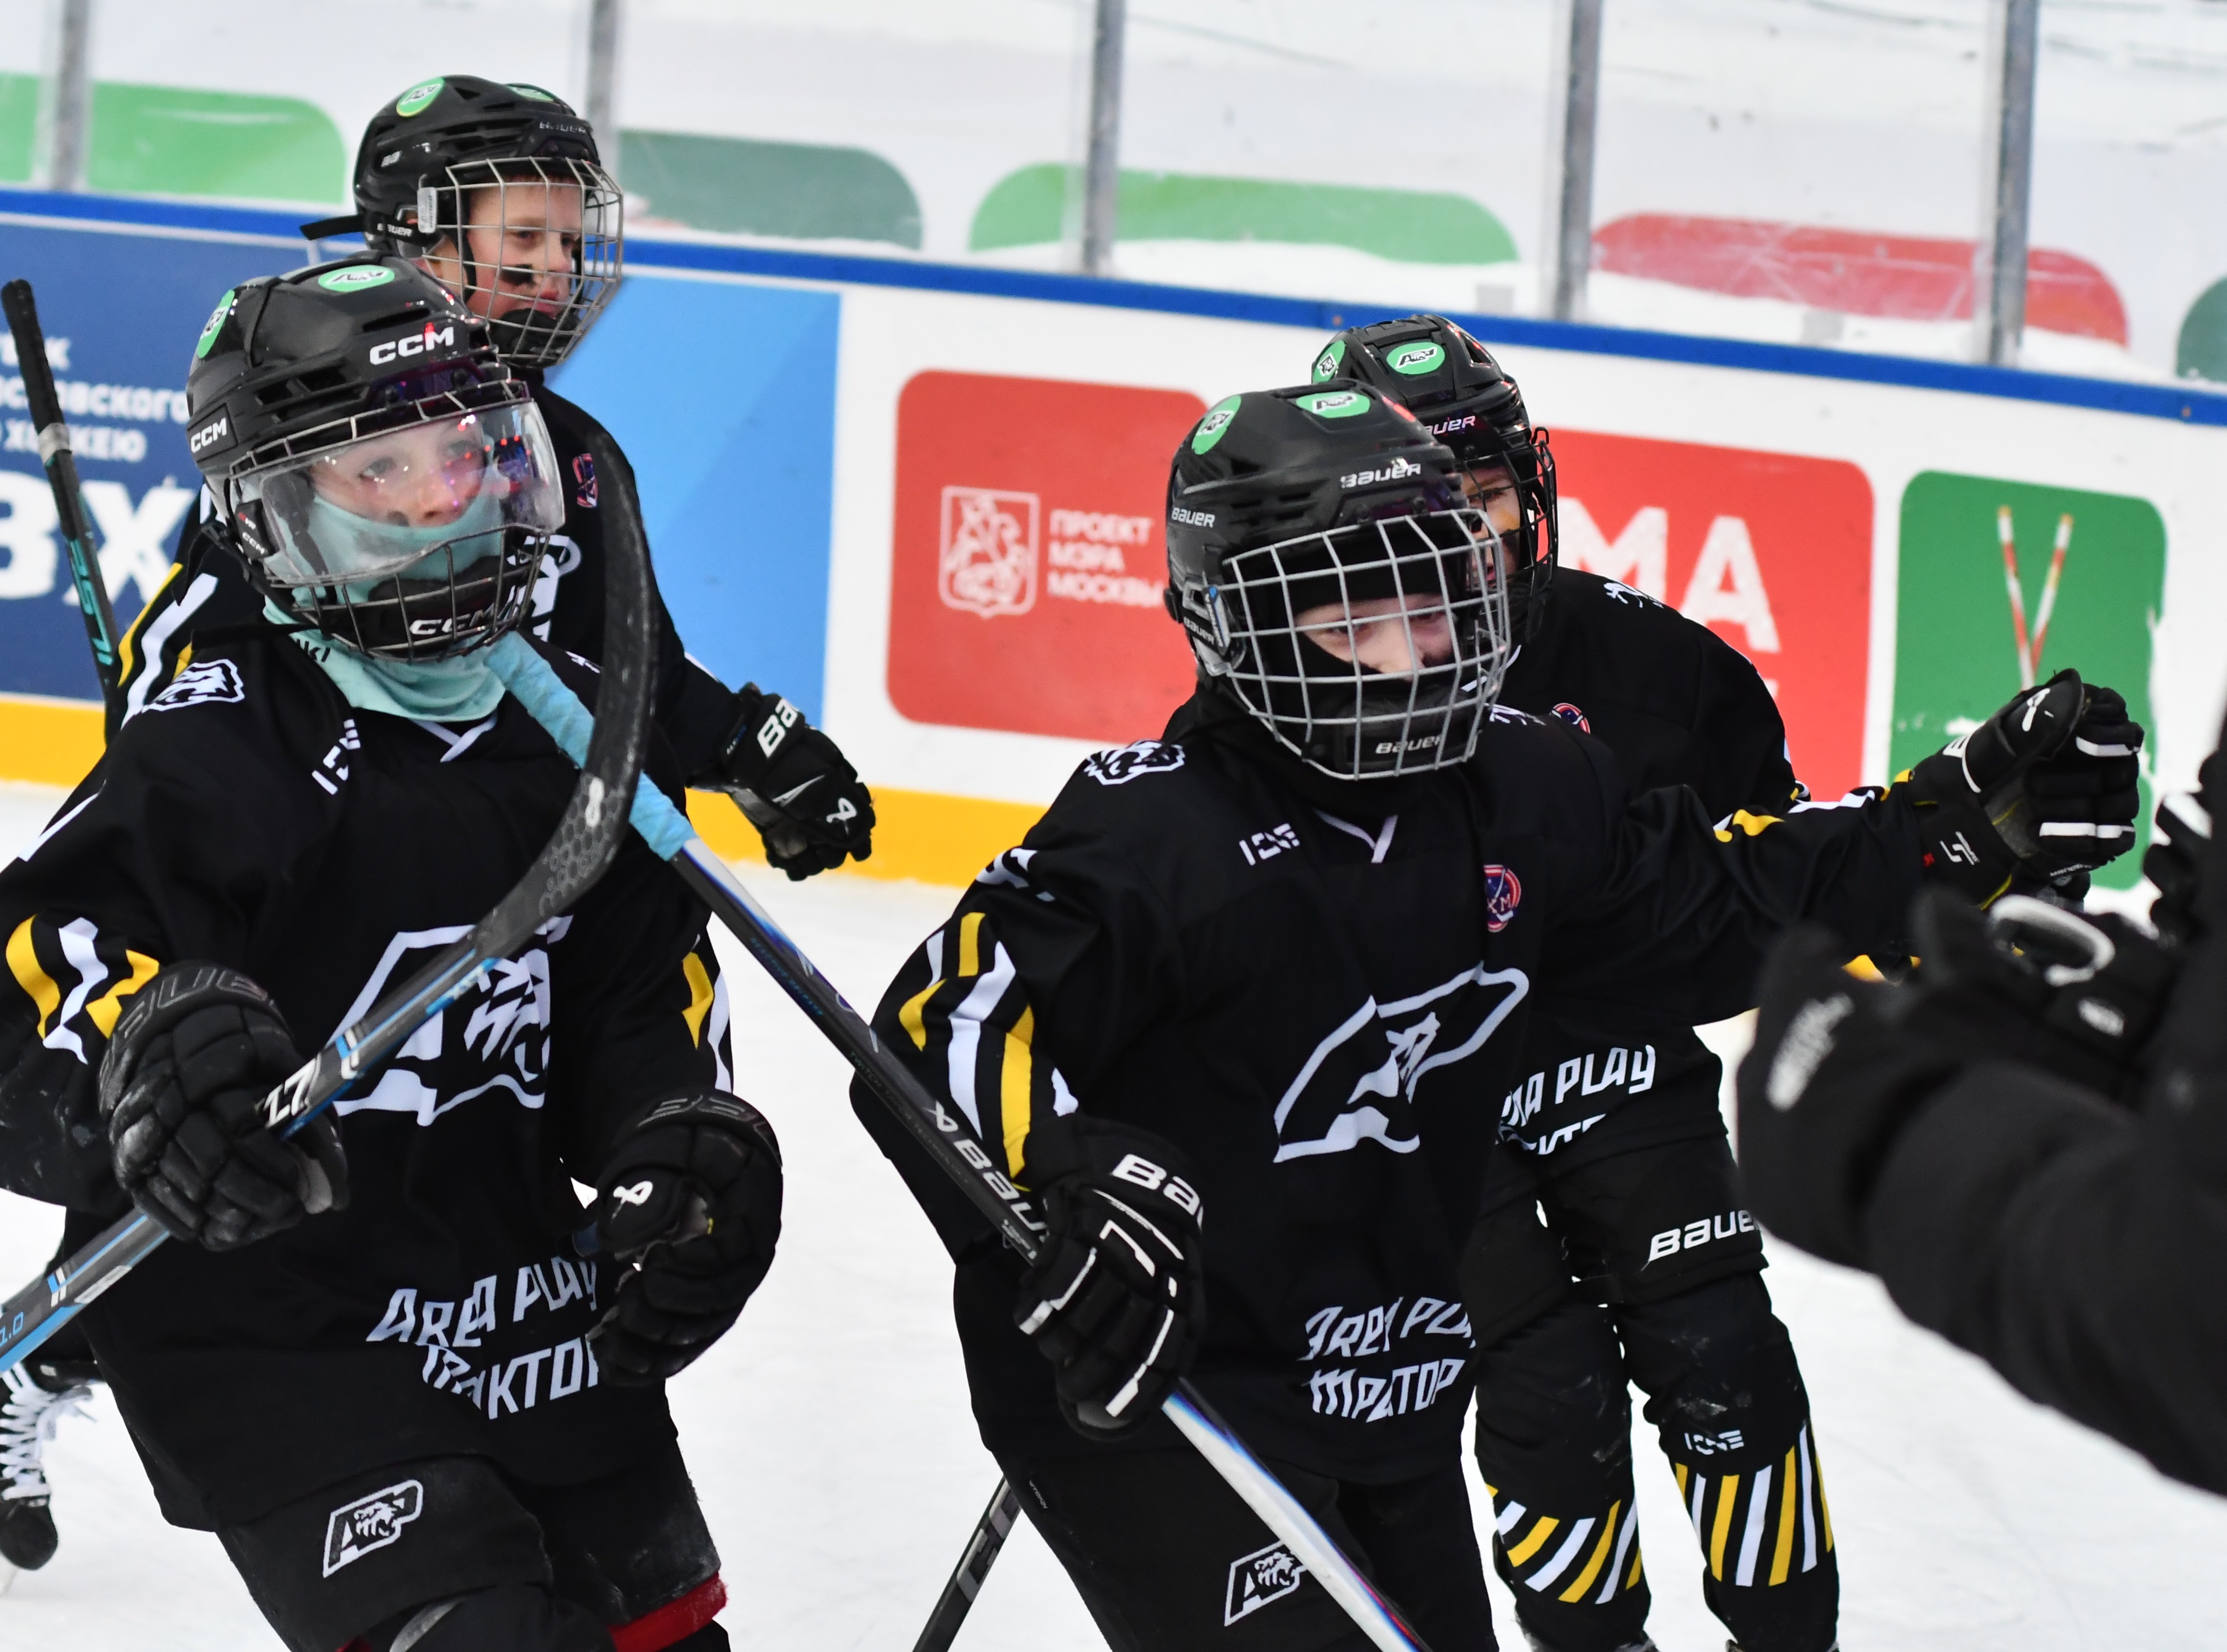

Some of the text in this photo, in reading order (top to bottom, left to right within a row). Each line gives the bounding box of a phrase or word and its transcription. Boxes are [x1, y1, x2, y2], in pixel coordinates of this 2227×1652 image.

[370, 326, 454, 366] CCM
[190, 417, 227, 453] CCM
[1423, 415, 1476, 435] AUER
[1340, 457, 1422, 489] BAUER
[1171, 507, 1215, 528] BAUER
[1555, 1044, 1656, 1105] PLAY
[1648, 1209, 1760, 1263] BAUE
[512, 1256, 597, 1313] PLAY
